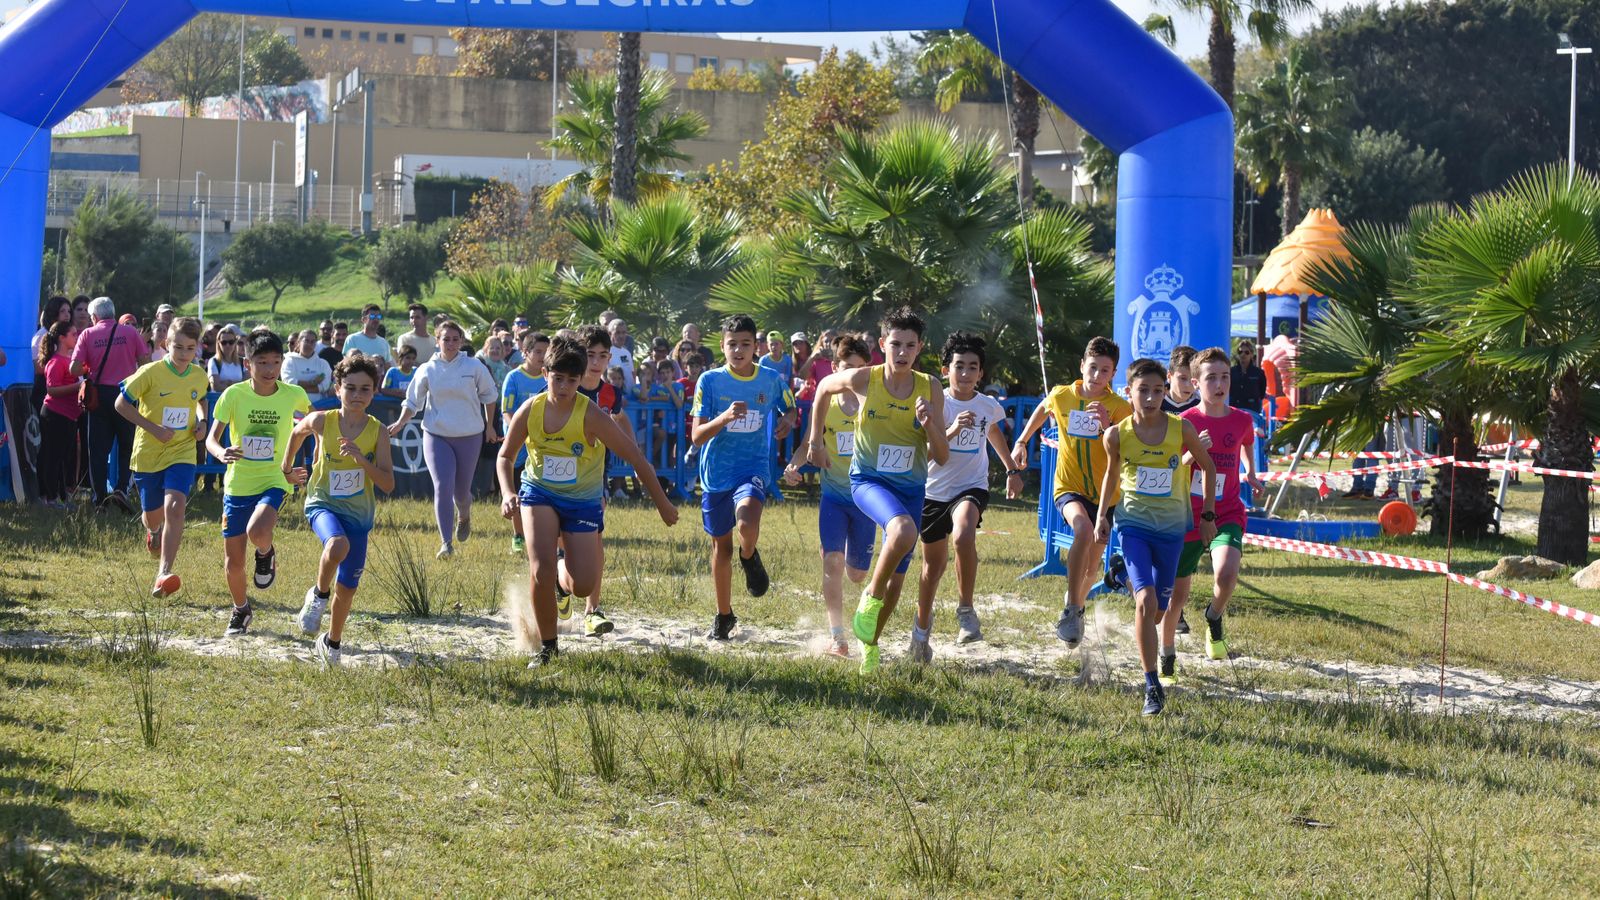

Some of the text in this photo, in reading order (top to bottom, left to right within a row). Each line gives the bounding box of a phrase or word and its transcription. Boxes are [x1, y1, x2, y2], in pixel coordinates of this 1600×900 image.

[167, 411, 186, 424] 412
[1072, 414, 1097, 432] 385
[957, 430, 977, 446] 182
[248, 438, 272, 457] 173
[545, 458, 575, 476] 360
[881, 448, 912, 469] 229
[334, 472, 361, 491] 231
[1138, 470, 1170, 489] 232
